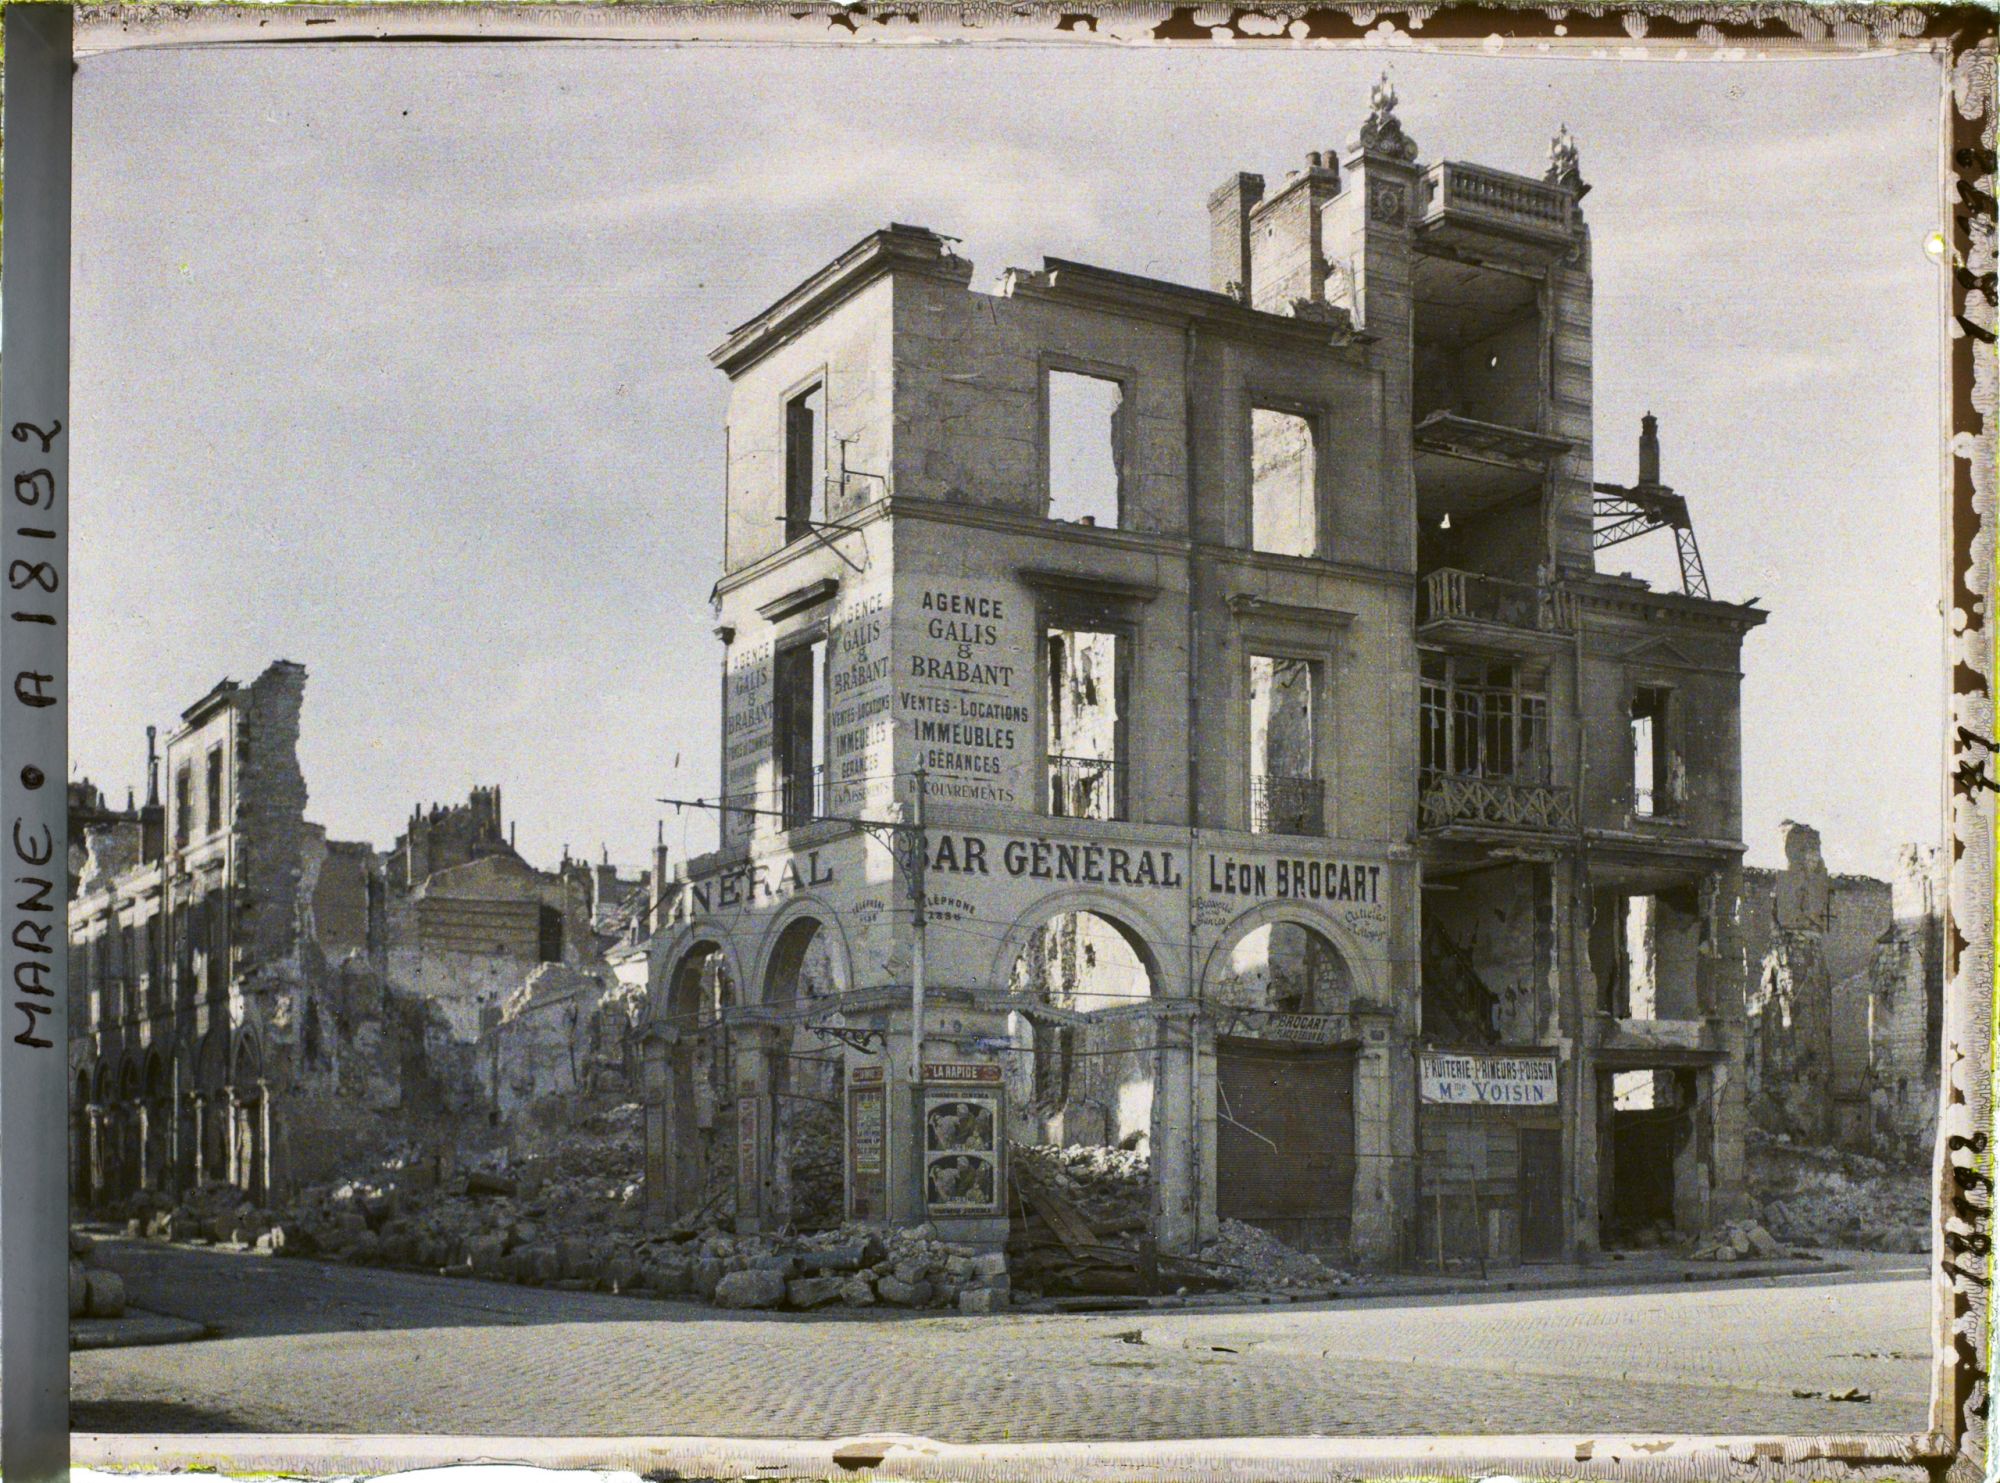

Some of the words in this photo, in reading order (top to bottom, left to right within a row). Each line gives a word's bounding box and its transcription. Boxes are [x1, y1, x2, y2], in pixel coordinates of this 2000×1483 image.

[9, 421, 60, 625] 18192
[922, 591, 1004, 619] AGENCE
[843, 619, 881, 654] GALIS
[929, 619, 997, 647] GALIS
[957, 643, 973, 659] &
[834, 656, 889, 696] BRABANT
[911, 655, 1014, 688] BRABANT
[14, 671, 56, 708] A
[914, 718, 1015, 750] IMMEUBLES
[909, 779, 1014, 802] RCOUVREMENTS
[1004, 838, 1181, 888] GÉNÉRAL
[1210, 855, 1266, 896] LÉON
[1277, 859, 1380, 902] BROCART
[13, 818, 53, 1049] MARNE
[1277, 1014, 1328, 1031] BROCART
[1472, 1081, 1545, 1102] VOISIN
